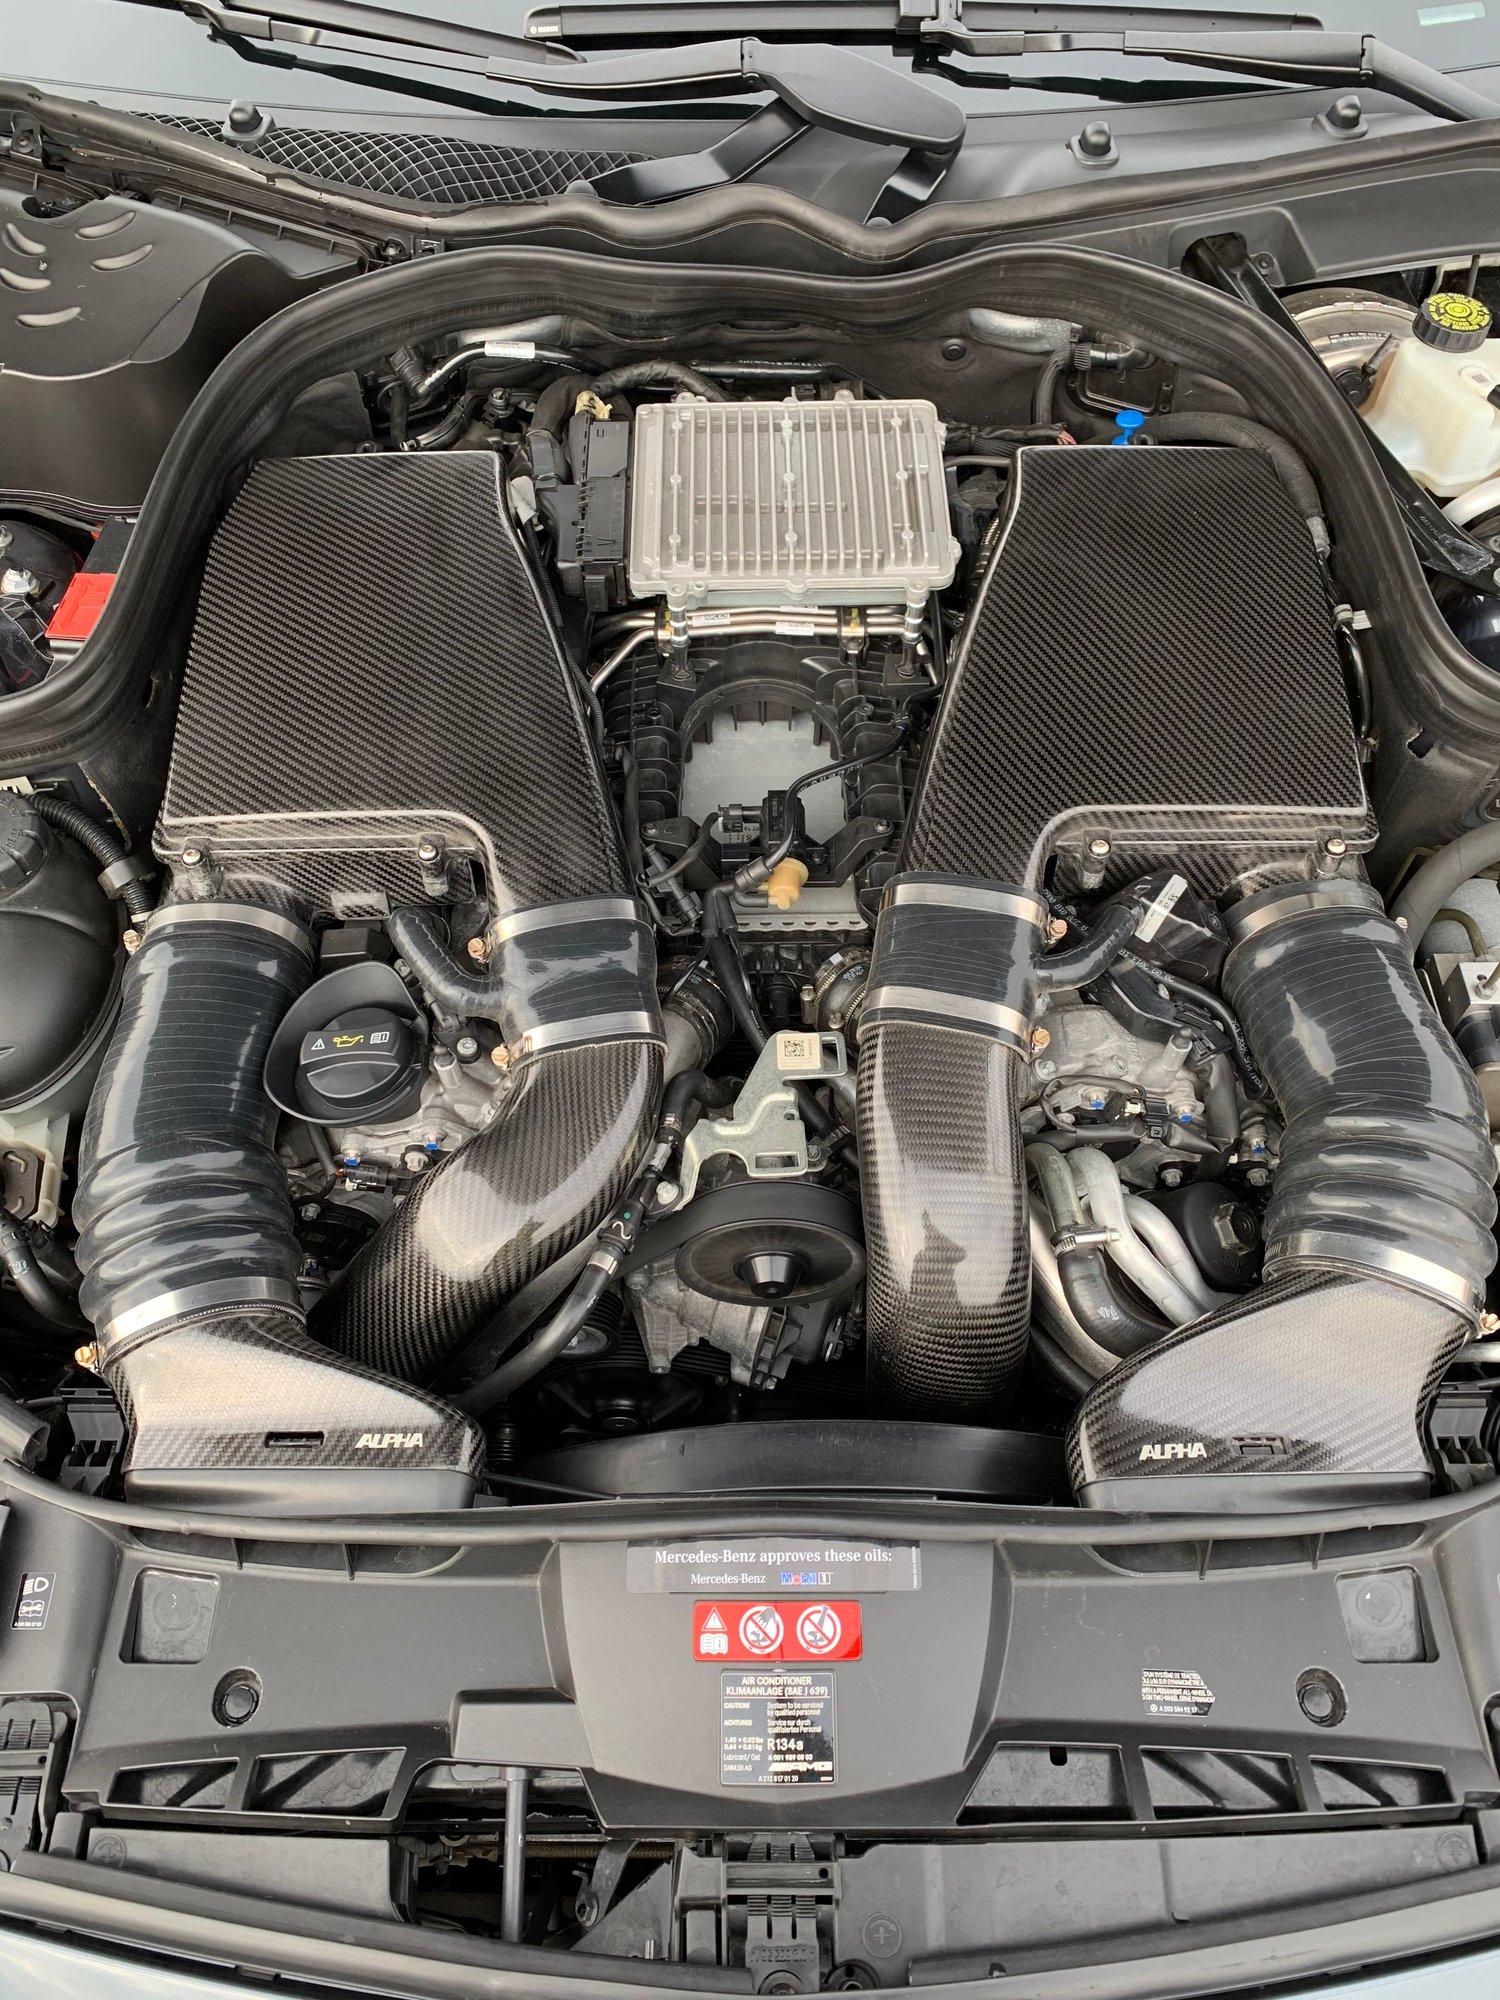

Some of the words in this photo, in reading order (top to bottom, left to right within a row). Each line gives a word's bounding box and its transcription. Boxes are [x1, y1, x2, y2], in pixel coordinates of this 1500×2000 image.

[354, 1433, 423, 1449] ALPHA
[1139, 1442, 1207, 1461] ALPHA
[655, 1549, 757, 1564] Mercedes-Benz
[759, 1551, 821, 1565] approves
[824, 1549, 861, 1562] these
[864, 1549, 893, 1562] oils:
[690, 1573, 767, 1585] Mercedes-Benz
[780, 1571, 817, 1585] Mobil
[741, 1676, 756, 1685] AIR
[756, 1676, 812, 1686] CONDITIONER
[726, 1686, 784, 1696] KLIMAANLAGE
[784, 1686, 803, 1697] (SAE
[803, 1687, 808, 1696] J
[809, 1686, 828, 1697] 639)
[767, 1702, 787, 1710] System
[1164, 1705, 1174, 1713] 203
[767, 1709, 774, 1717] by
[774, 1709, 796, 1717] qualified
[796, 1709, 821, 1717] personnel
[723, 1719, 753, 1727] ACHTUNG!
[767, 1719, 787, 1727] Service
[767, 1726, 799, 1734] qualifiziertes
[767, 1738, 804, 1751] R134a
[745, 1764, 753, 1772] AG
